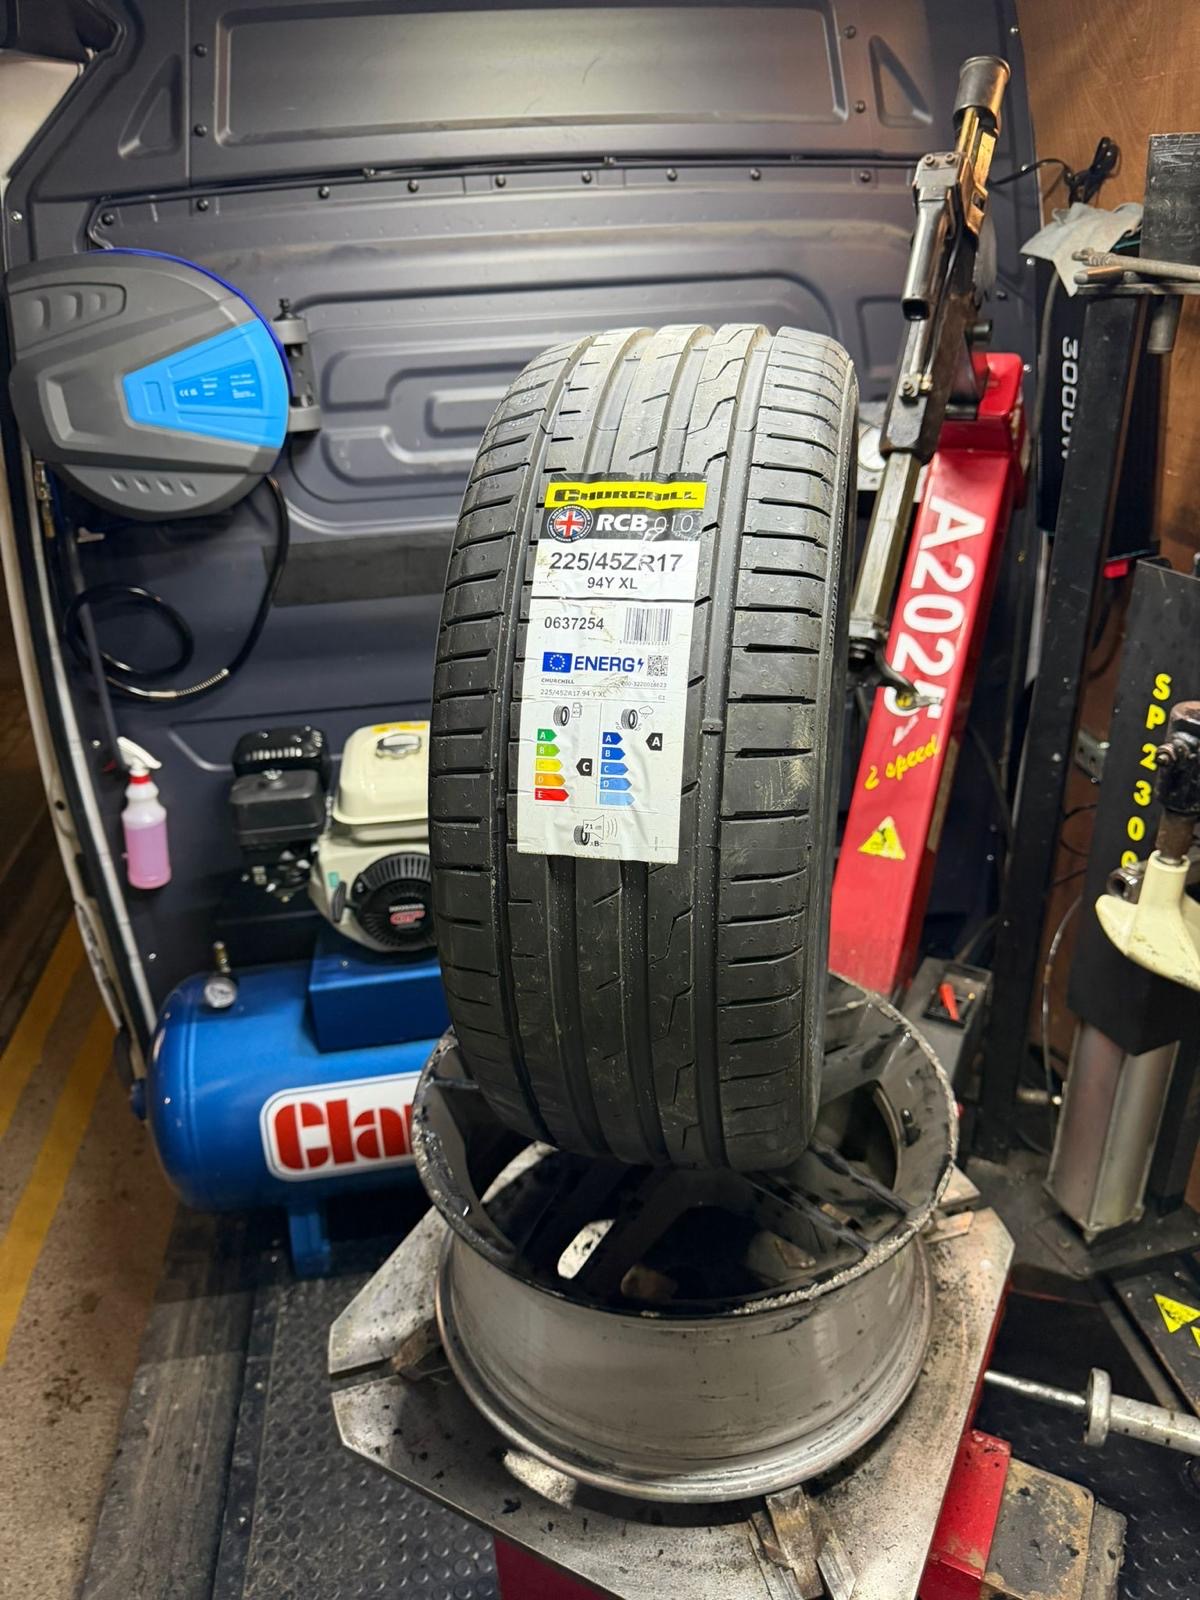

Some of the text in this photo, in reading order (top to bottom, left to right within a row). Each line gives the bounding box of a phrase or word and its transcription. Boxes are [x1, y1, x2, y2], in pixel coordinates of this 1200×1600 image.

[554, 489, 697, 502] CHURCHILL
[549, 552, 683, 573] 225/45ZR17
[587, 577, 638, 590] 94Y XL
[883, 495, 986, 719] A2025
[544, 616, 605, 630] 0637254
[574, 655, 635, 672] ENERG
[652, 737, 661, 746] A
[885, 734, 939, 781] speed
[582, 762, 590, 772] C
[603, 780, 610, 788] D
